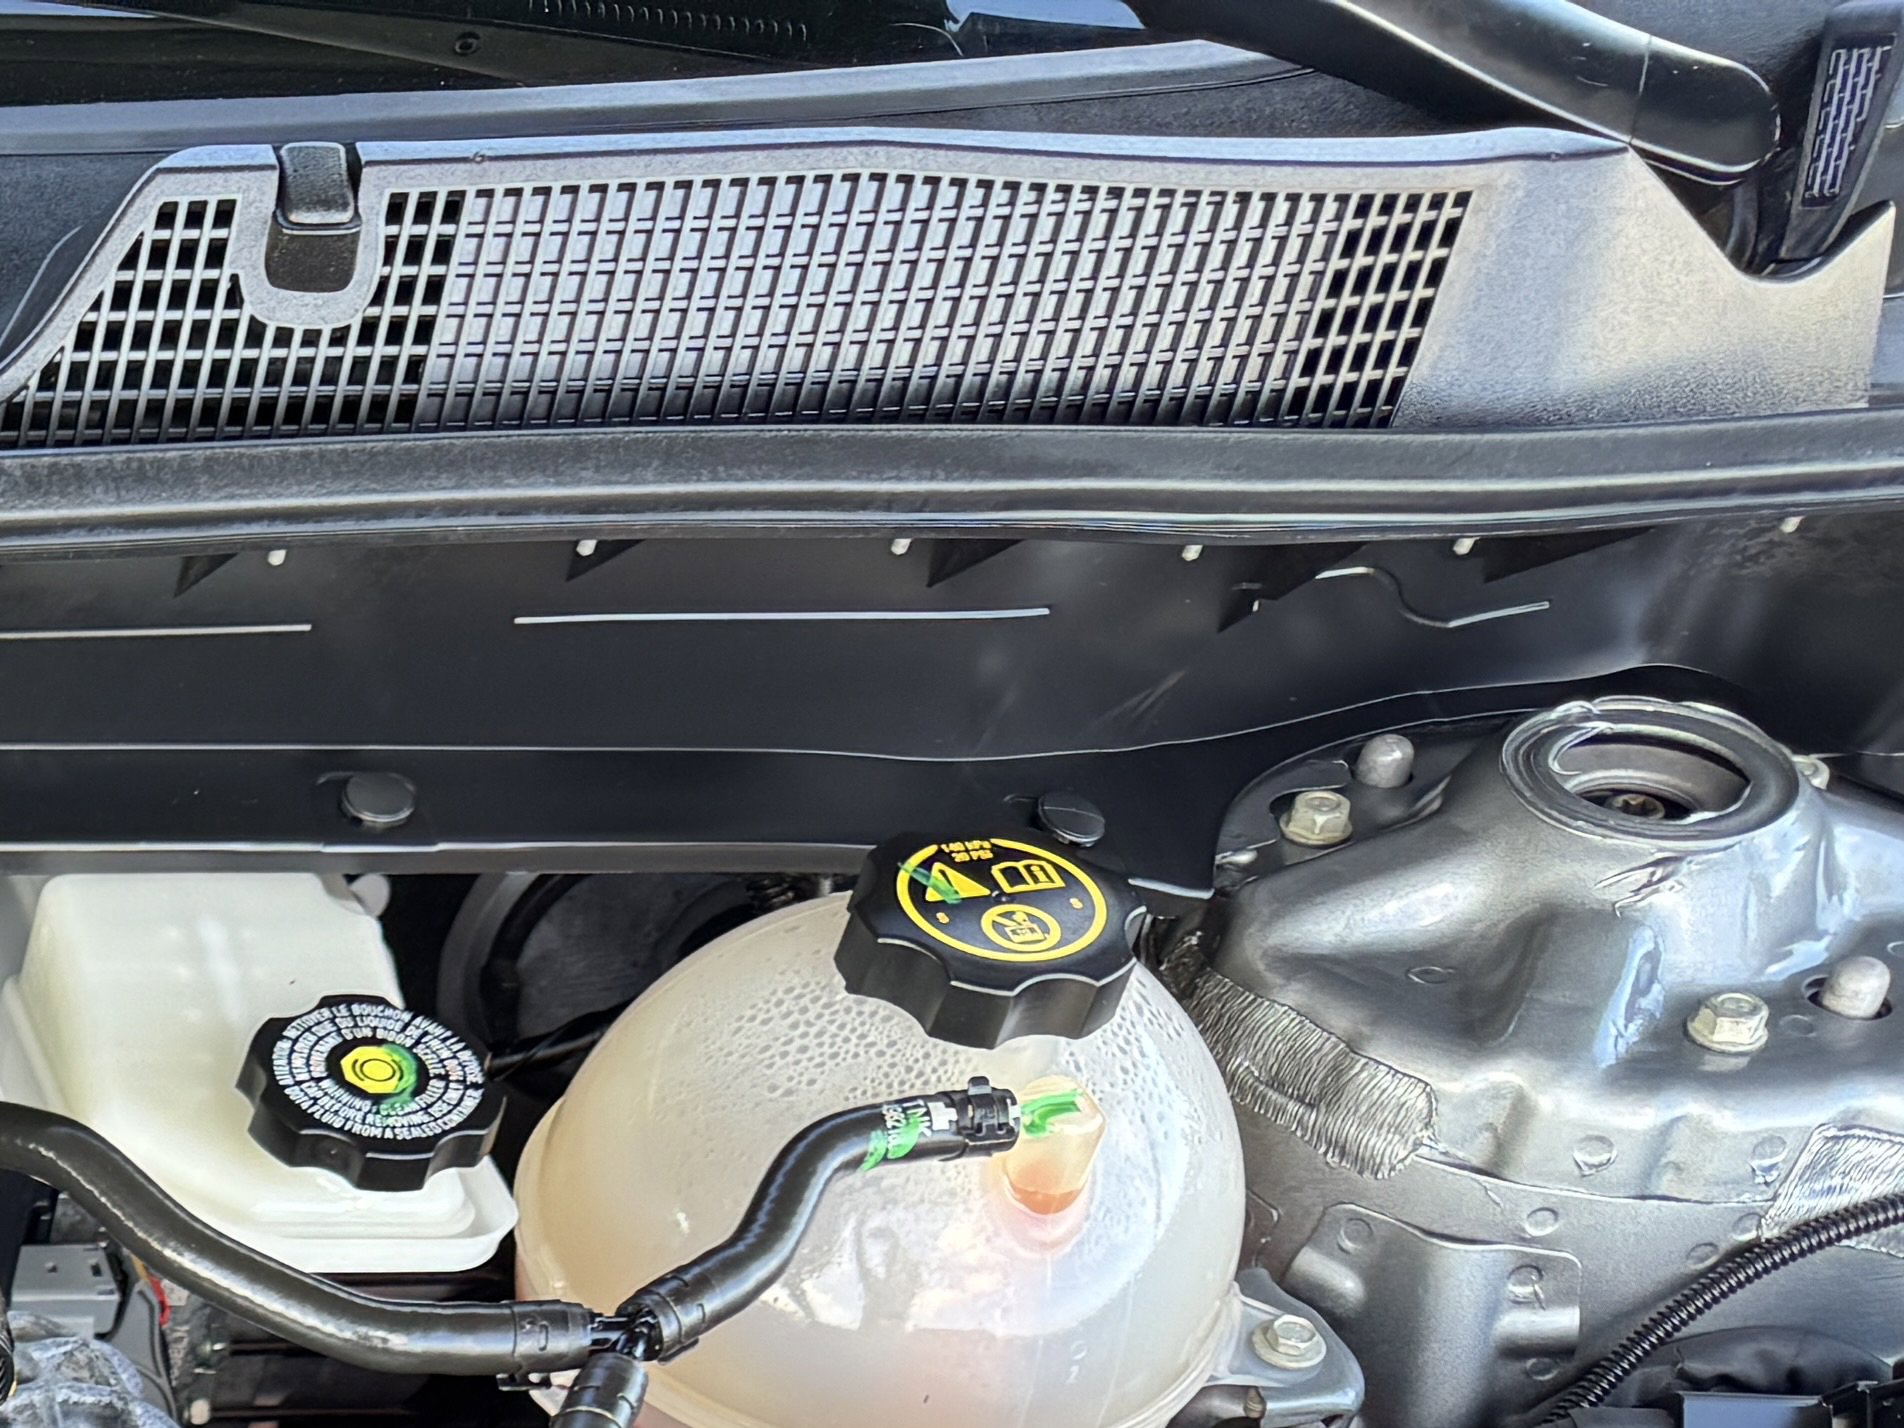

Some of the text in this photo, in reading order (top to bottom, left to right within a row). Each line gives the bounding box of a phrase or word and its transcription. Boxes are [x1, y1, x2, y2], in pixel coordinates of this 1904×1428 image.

[282, 1007, 332, 1039] NETTOYER
[330, 1003, 350, 1017] LE
[350, 1002, 412, 1021] BOUCHON
[411, 1015, 452, 1039] AVANT
[445, 1036, 466, 1051] LA
[340, 1025, 373, 1040] D'UN
[375, 1025, 416, 1047] BIDON
[355, 1013, 406, 1031] LIQUIDE
[404, 1022, 427, 1038] DE
[421, 1031, 458, 1059] FREIN
[299, 1080, 324, 1098] CAP
[316, 1095, 364, 1123] BEFORE
[427, 1099, 453, 1118] USE
[414, 1078, 445, 1107] FILLER
[306, 1104, 345, 1128] FLUID
[343, 1120, 382, 1138] FROM
[383, 1127, 394, 1139] A
[393, 1121, 442, 1140] SEALED
